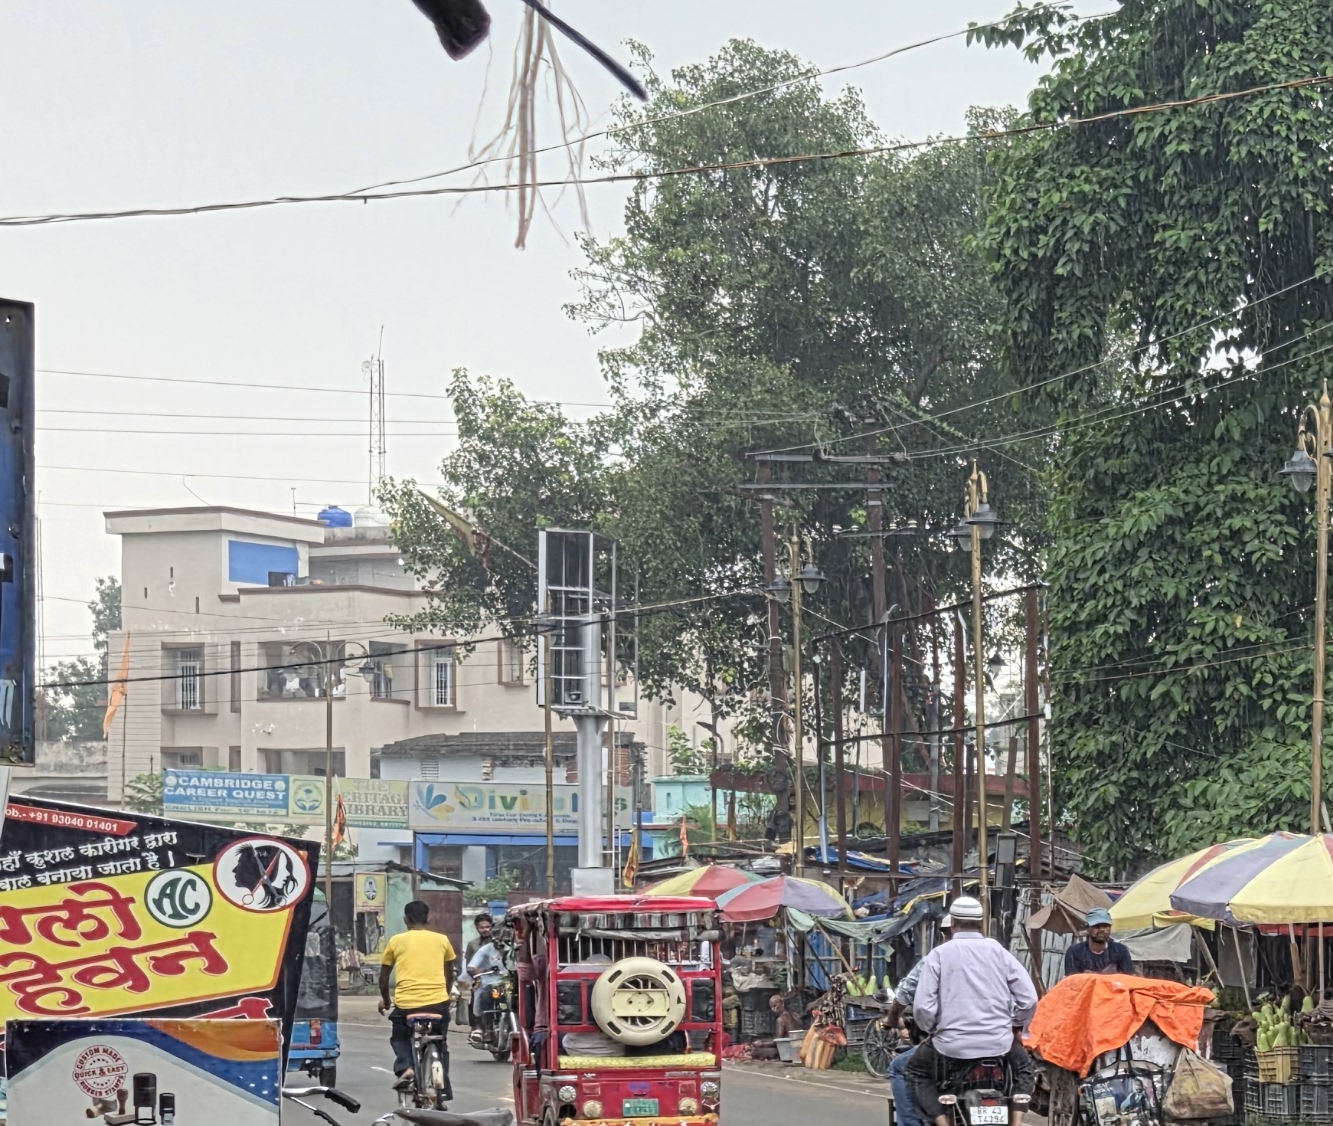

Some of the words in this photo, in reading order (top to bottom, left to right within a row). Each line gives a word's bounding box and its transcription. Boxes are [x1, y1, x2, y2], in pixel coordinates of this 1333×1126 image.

[178, 776, 273, 790] CAMBRIDGE
[164, 786, 228, 798] CAREER
[232, 788, 287, 800] QUEST
[335, 790, 408, 805] ERITAG
[341, 803, 408, 817] IBRARY
[5, 807, 27, 818] ob.-
[29, 812, 48, 822] +91
[52, 814, 84, 827] 93040
[86, 820, 118, 832] 01401
[0, 850, 22, 872] हाँ
[25, 847, 75, 869] कुशल
[78, 837, 140, 857] कारीगर
[97, 858, 141, 875] जाता
[152, 877, 201, 920] AC
[76, 1047, 100, 1070] CUSTOM
[102, 1047, 121, 1063] MADE
[74, 1070, 96, 1079] QUICK
[107, 1065, 125, 1074] EASY
[80, 1080, 103, 1097] RUBBER
